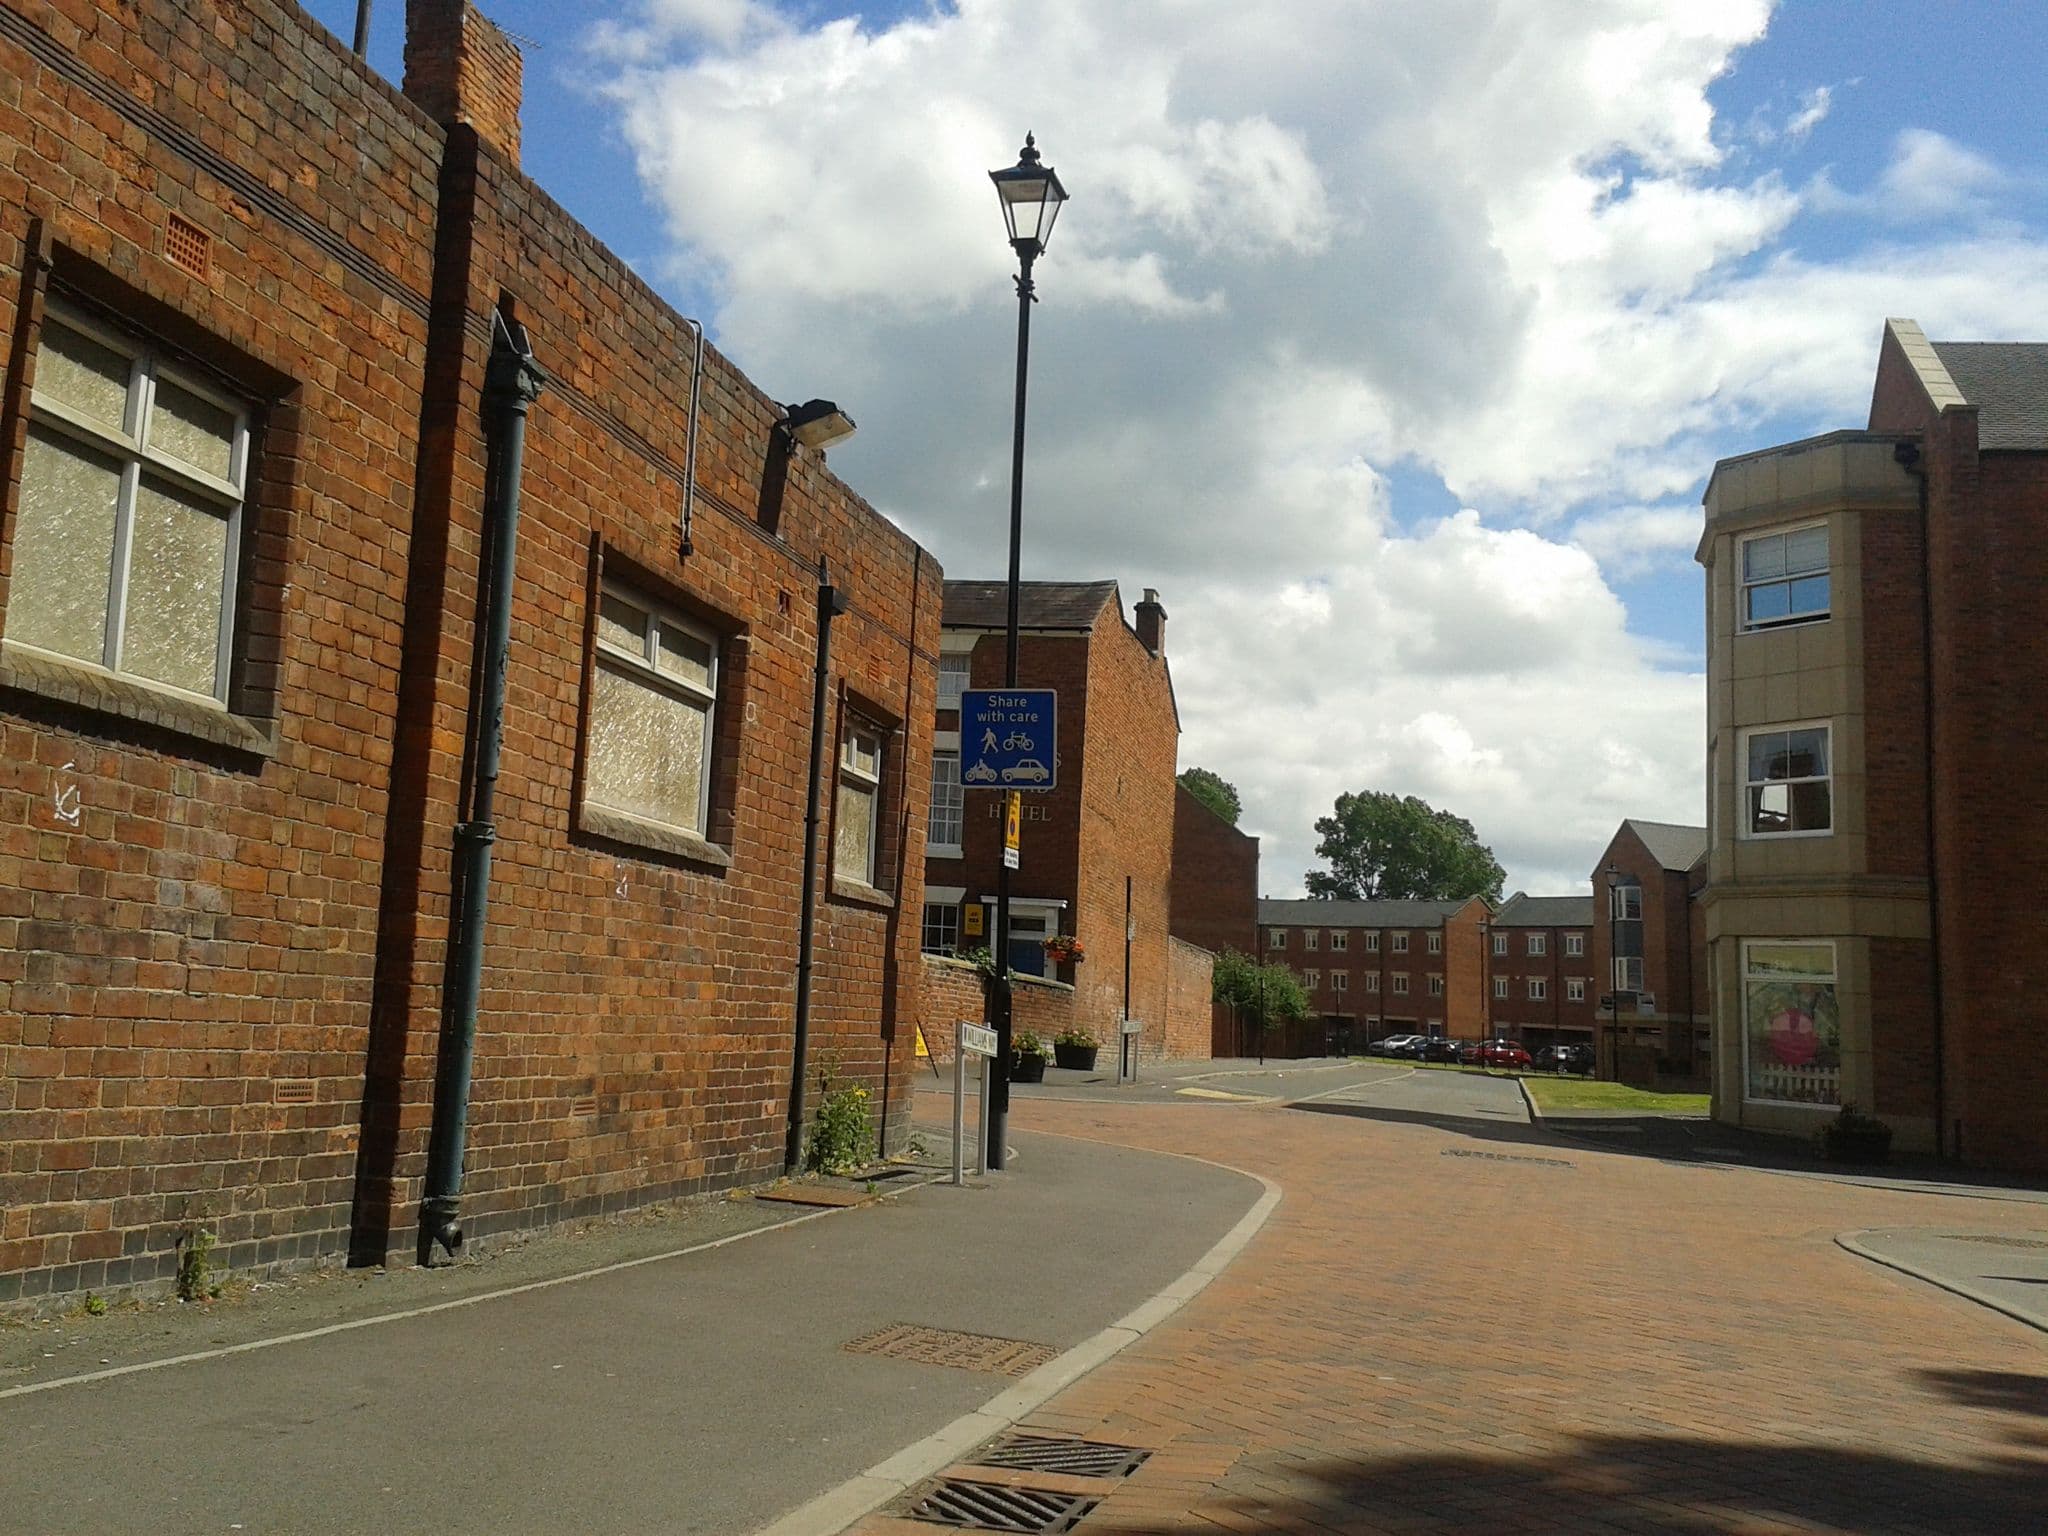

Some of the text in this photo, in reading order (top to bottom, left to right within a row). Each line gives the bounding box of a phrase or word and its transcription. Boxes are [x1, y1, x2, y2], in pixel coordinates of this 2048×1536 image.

[988, 695, 1028, 708] Share
[976, 710, 1039, 722] with care
[988, 803, 1052, 822] HTEL
